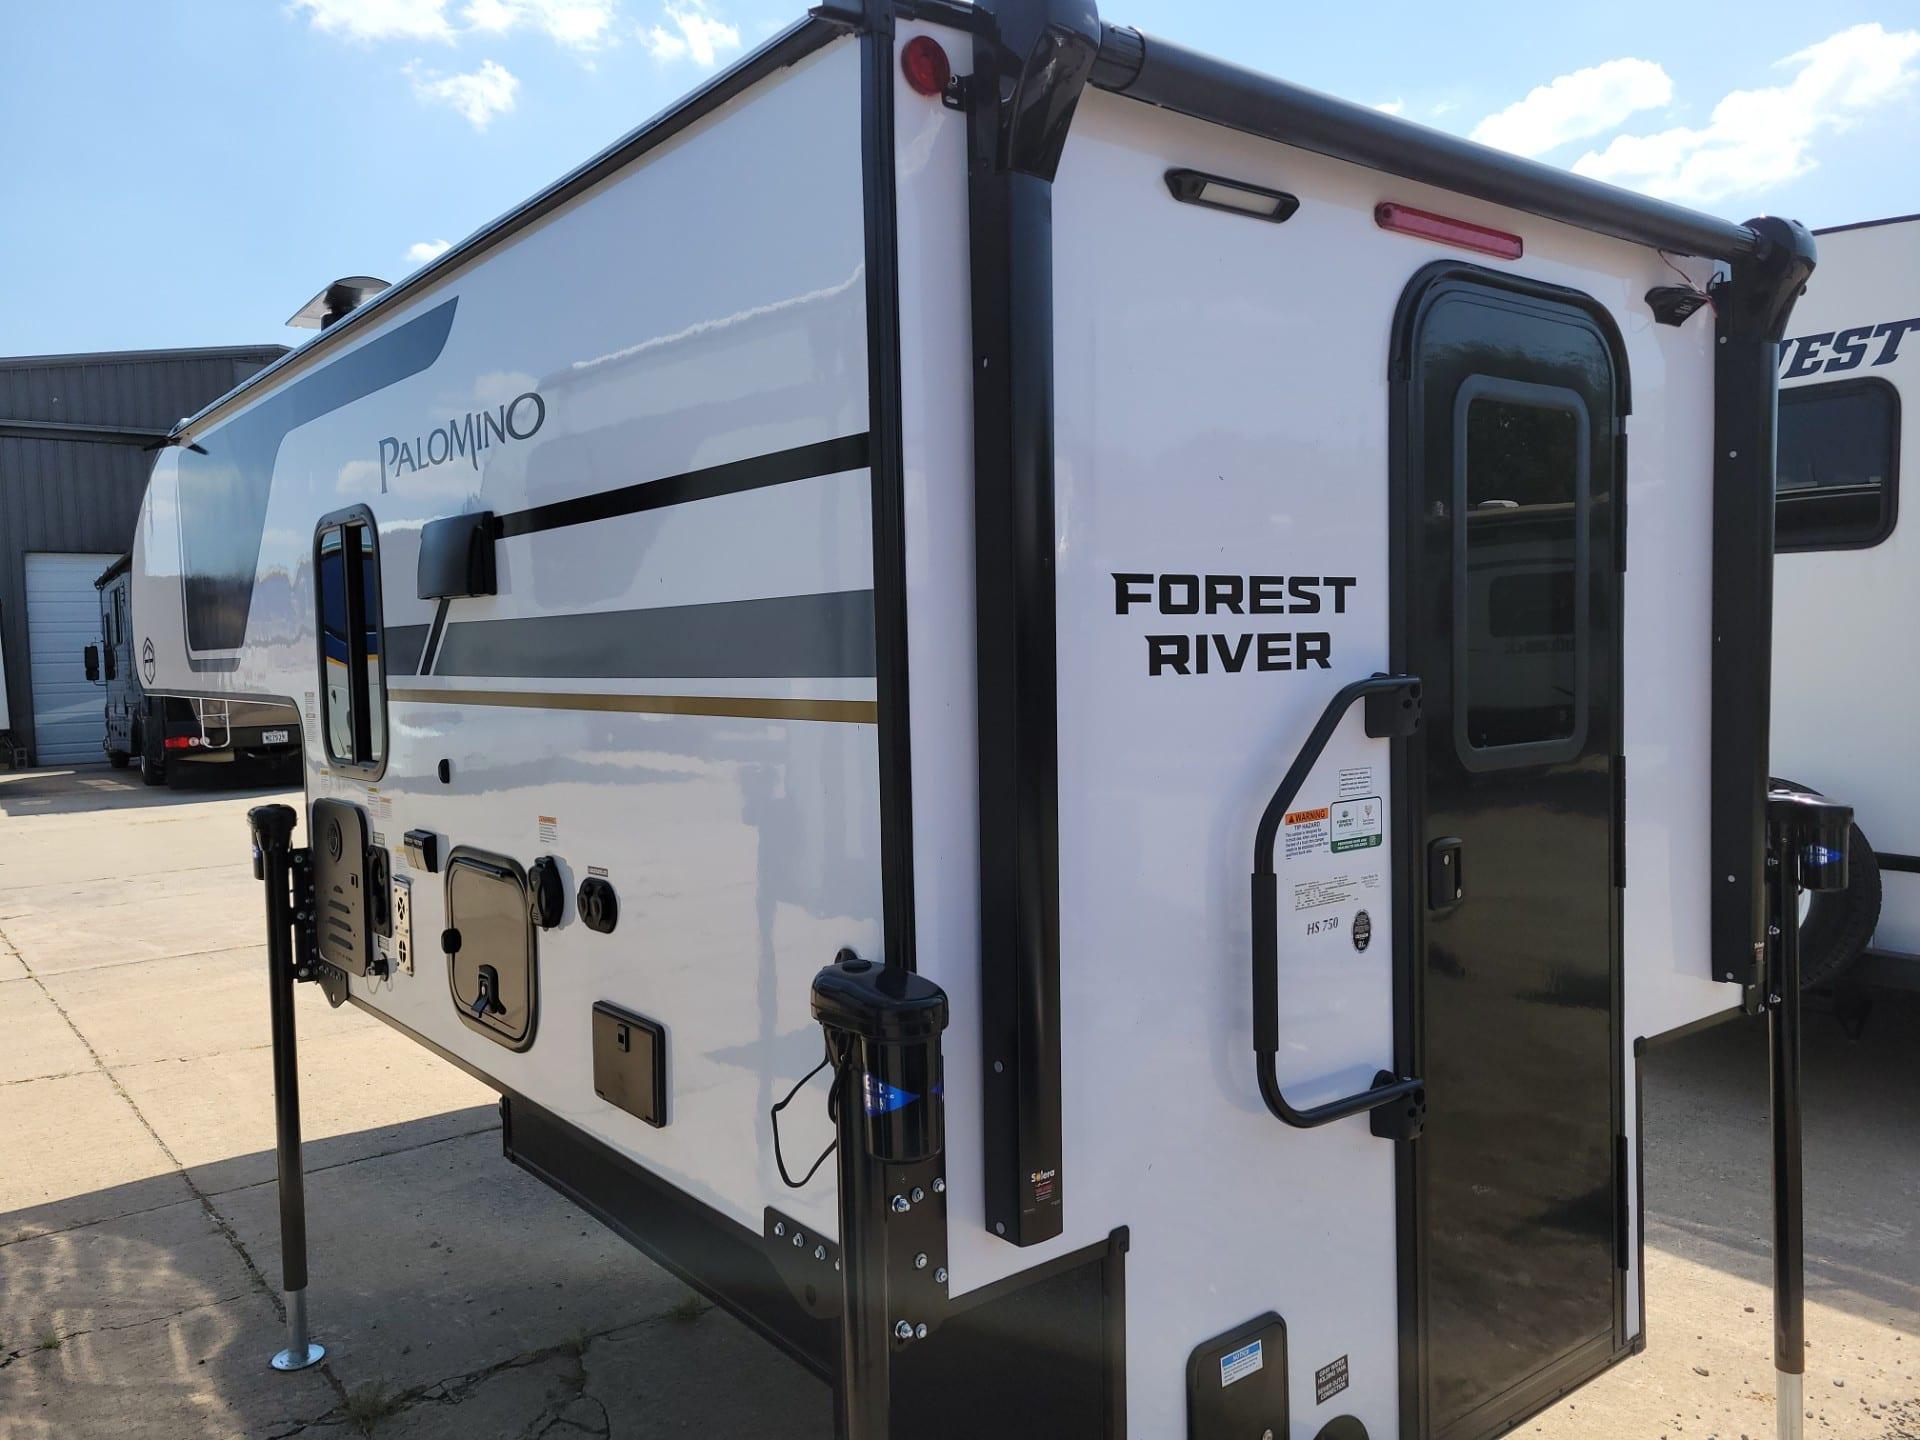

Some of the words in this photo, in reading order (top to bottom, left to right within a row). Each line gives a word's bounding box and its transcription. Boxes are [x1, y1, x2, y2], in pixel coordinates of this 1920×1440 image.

[1778, 317, 1920, 379] EST
[379, 392, 546, 494] PALOMINO
[1110, 573, 1357, 615] FOREST
[1144, 632, 1332, 676] RIVER
[1296, 809, 1326, 822] WARNING
[1302, 821, 1321, 829] HAZARD
[1307, 921, 1320, 935] HS
[1323, 917, 1339, 932] 750
